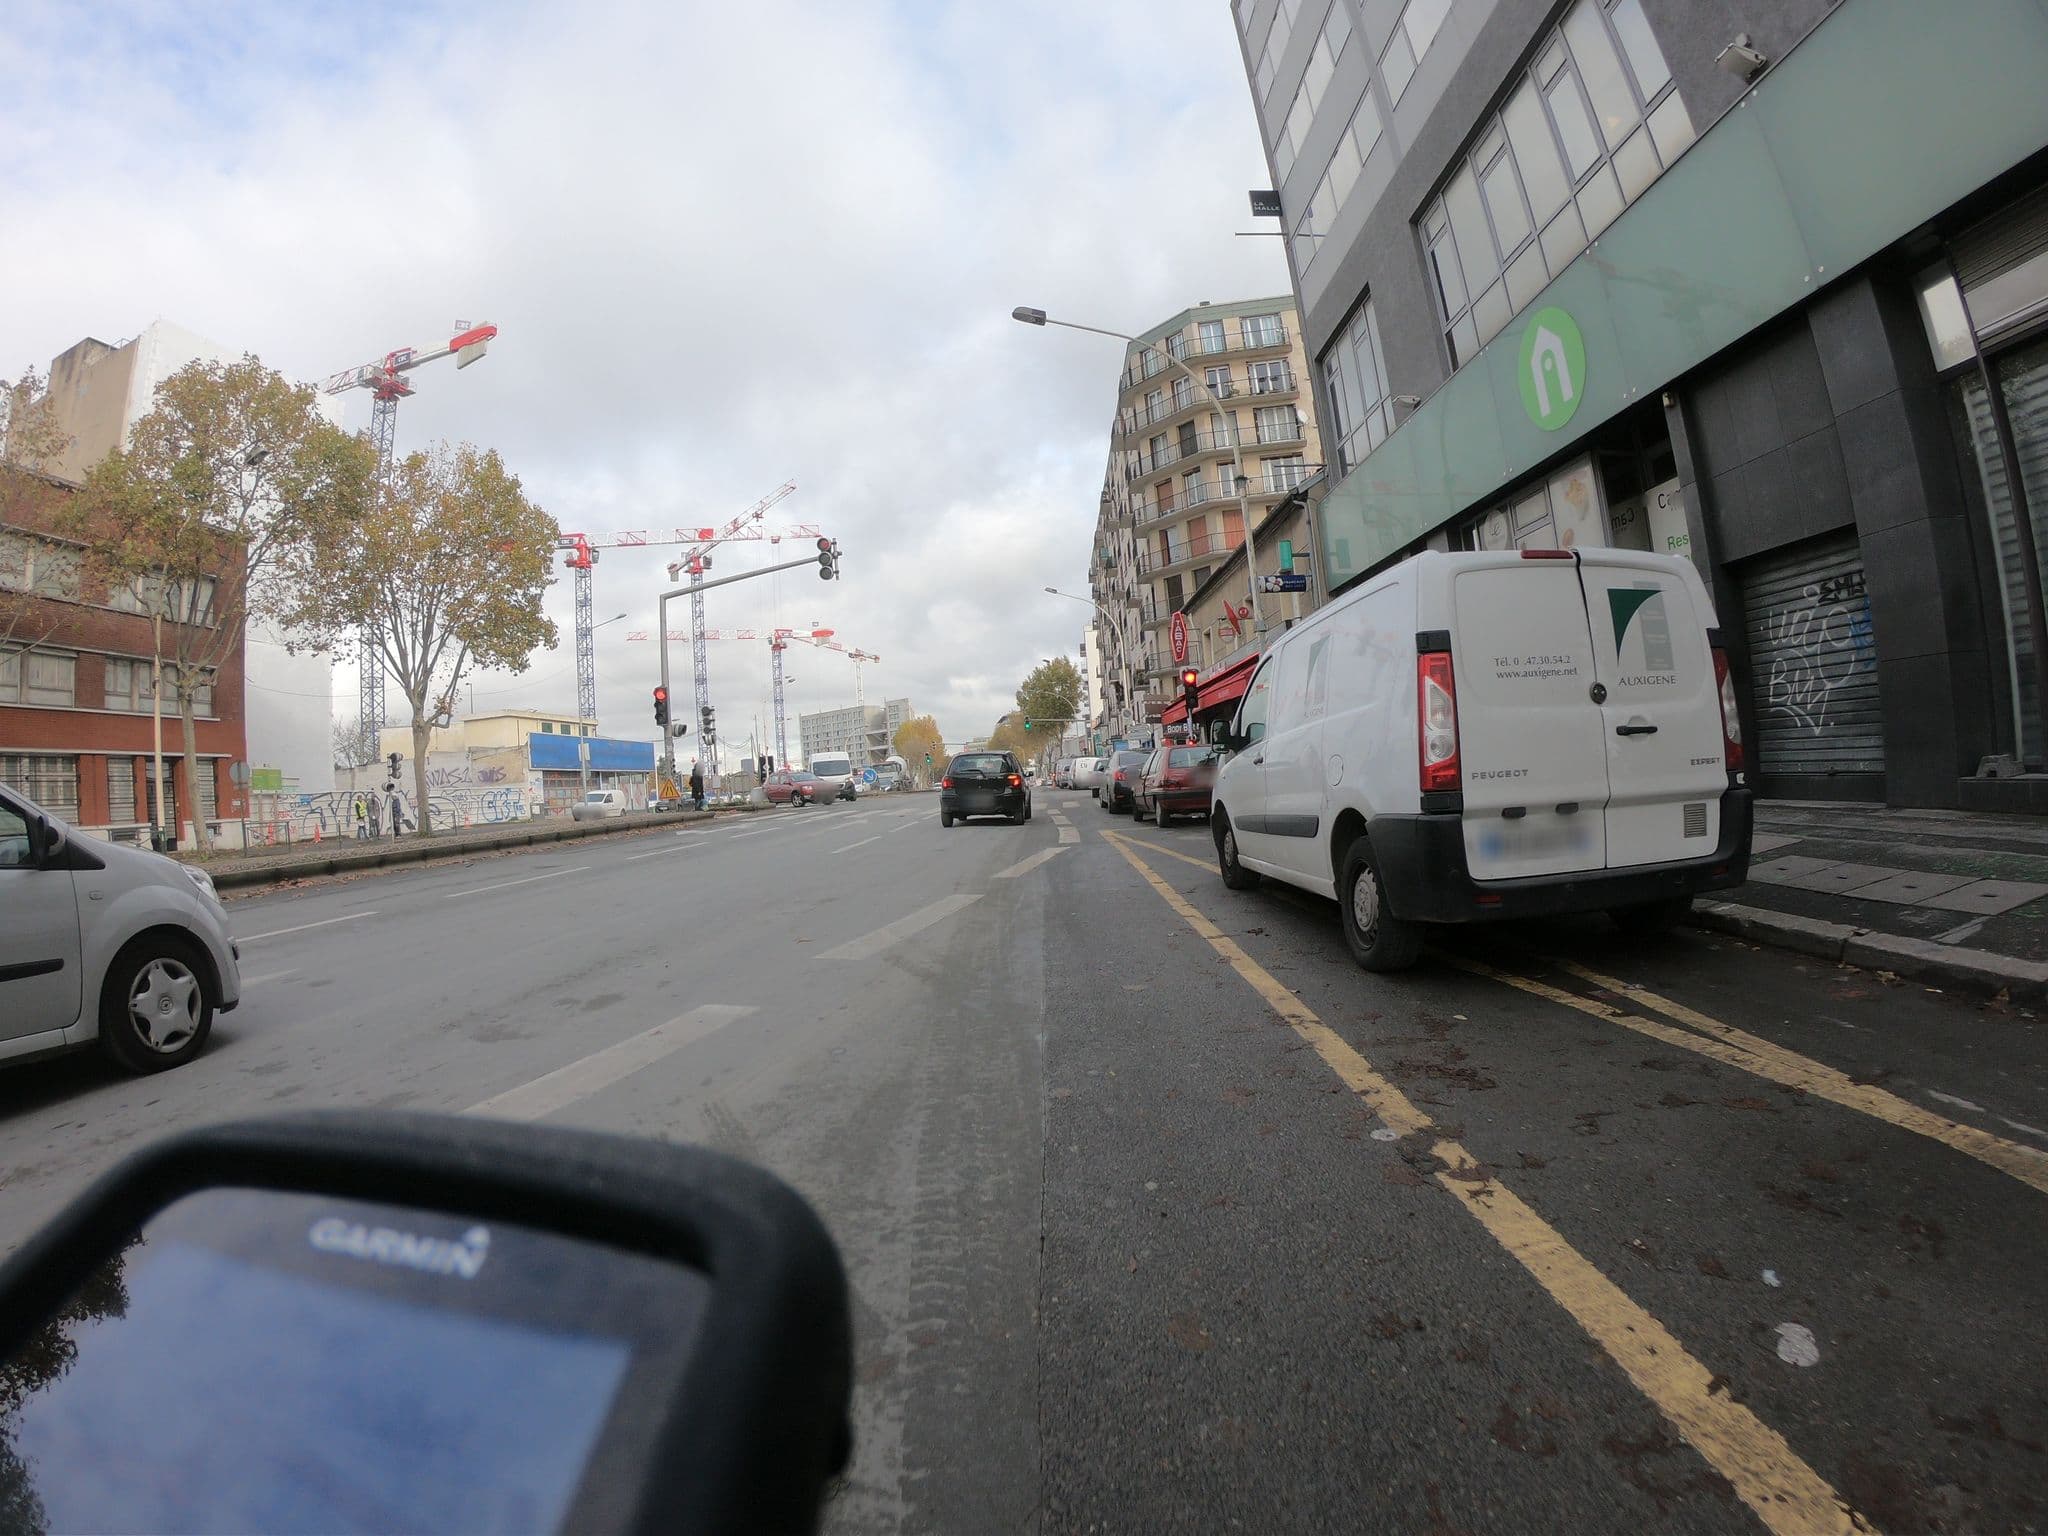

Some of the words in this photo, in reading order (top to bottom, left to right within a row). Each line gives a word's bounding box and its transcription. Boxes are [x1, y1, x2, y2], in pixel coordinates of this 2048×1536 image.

[1174, 620, 1183, 653] TABAC
[1496, 667, 1578, 680] www.auxigene.net
[1618, 675, 1677, 687] AUXIGENE
[1690, 757, 1720, 766] EXPERT
[1471, 769, 1529, 781] PEUGEOT
[308, 1217, 491, 1279] GARMIN
